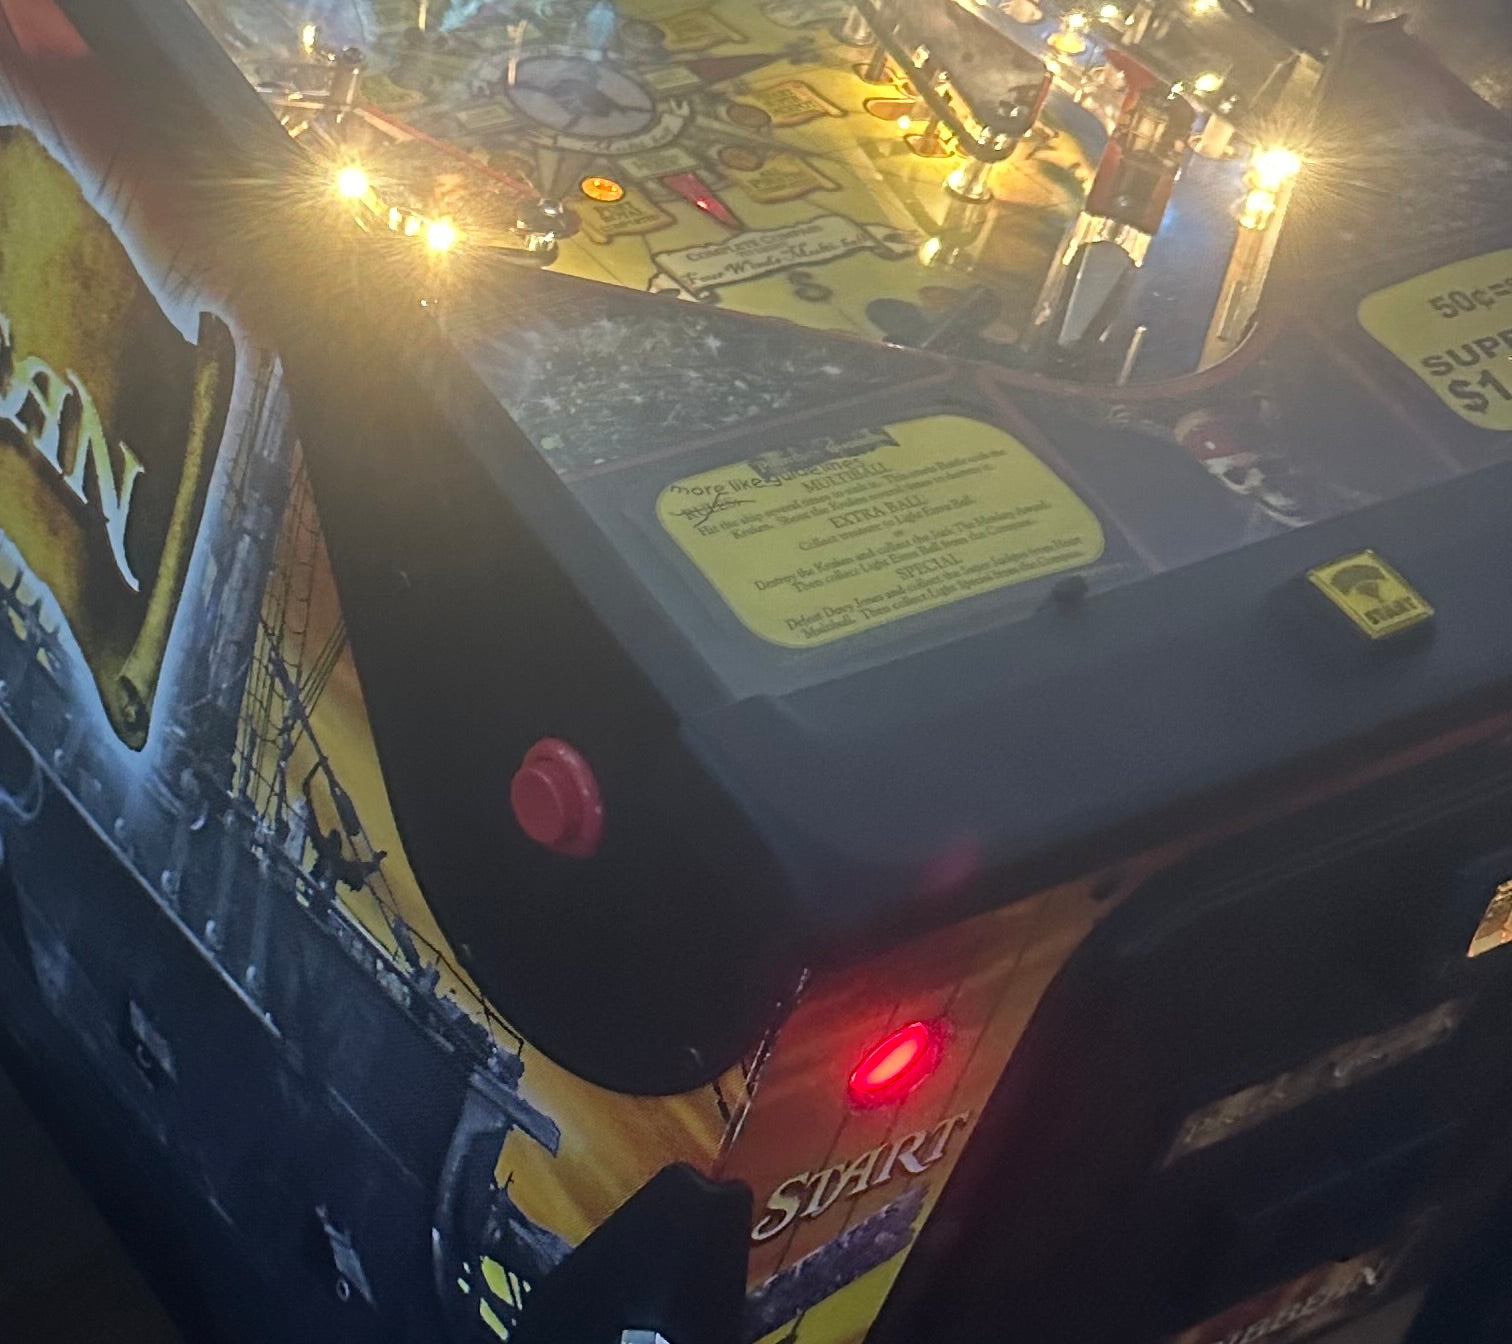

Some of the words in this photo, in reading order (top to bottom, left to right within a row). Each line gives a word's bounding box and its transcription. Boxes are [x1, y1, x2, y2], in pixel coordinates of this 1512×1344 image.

[670, 483, 727, 497] more
[729, 477, 763, 492] like
[800, 459, 890, 492] MULTIBALL
[827, 504, 886, 529] EXTRA
[881, 492, 930, 514] BALL
[892, 551, 965, 580] SPECIAL
[750, 1111, 969, 1242] START
